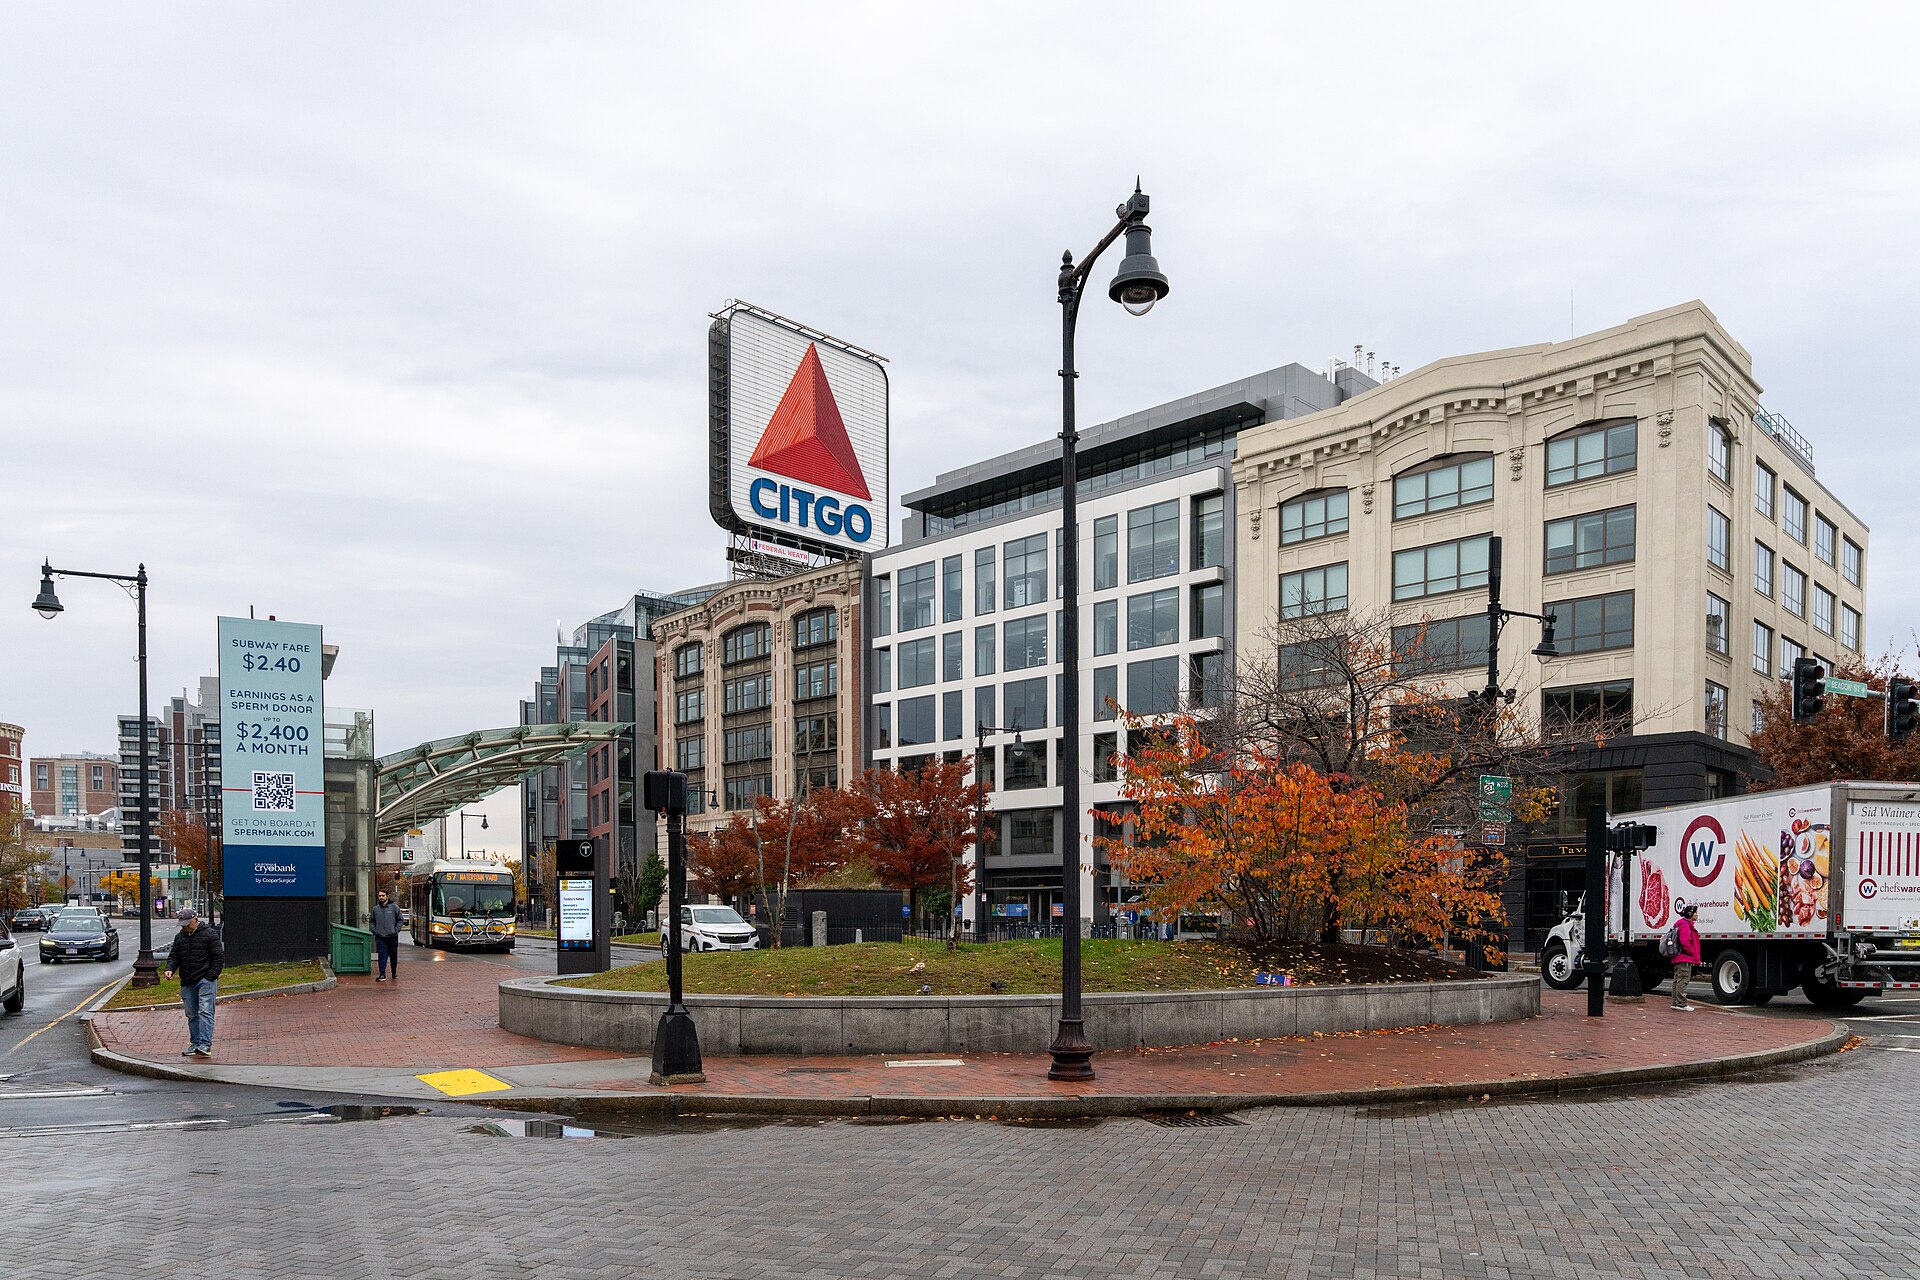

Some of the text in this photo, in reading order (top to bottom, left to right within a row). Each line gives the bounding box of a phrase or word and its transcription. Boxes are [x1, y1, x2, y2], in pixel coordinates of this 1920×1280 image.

[750, 477, 873, 543] CITGO
[758, 543, 808, 560] FEDERAL HEATH
[232, 638, 310, 653] SUBWAY FARE
[242, 652, 301, 673] $2.40
[1831, 681, 1852, 691] BEACON
[230, 689, 314, 703] EARNINGS AS A
[231, 701, 313, 714] SPERM DONOR
[236, 720, 309, 742] $2,400
[236, 742, 308, 756] A MONTH
[1861, 806, 1877, 817] Sid
[1880, 806, 1915, 818] Wainer
[231, 818, 316, 828] GET ON BOARD AT
[234, 828, 315, 837] SPERMBANK.COM
[254, 863, 296, 873] cryobank
[446, 872, 457, 881] 57
